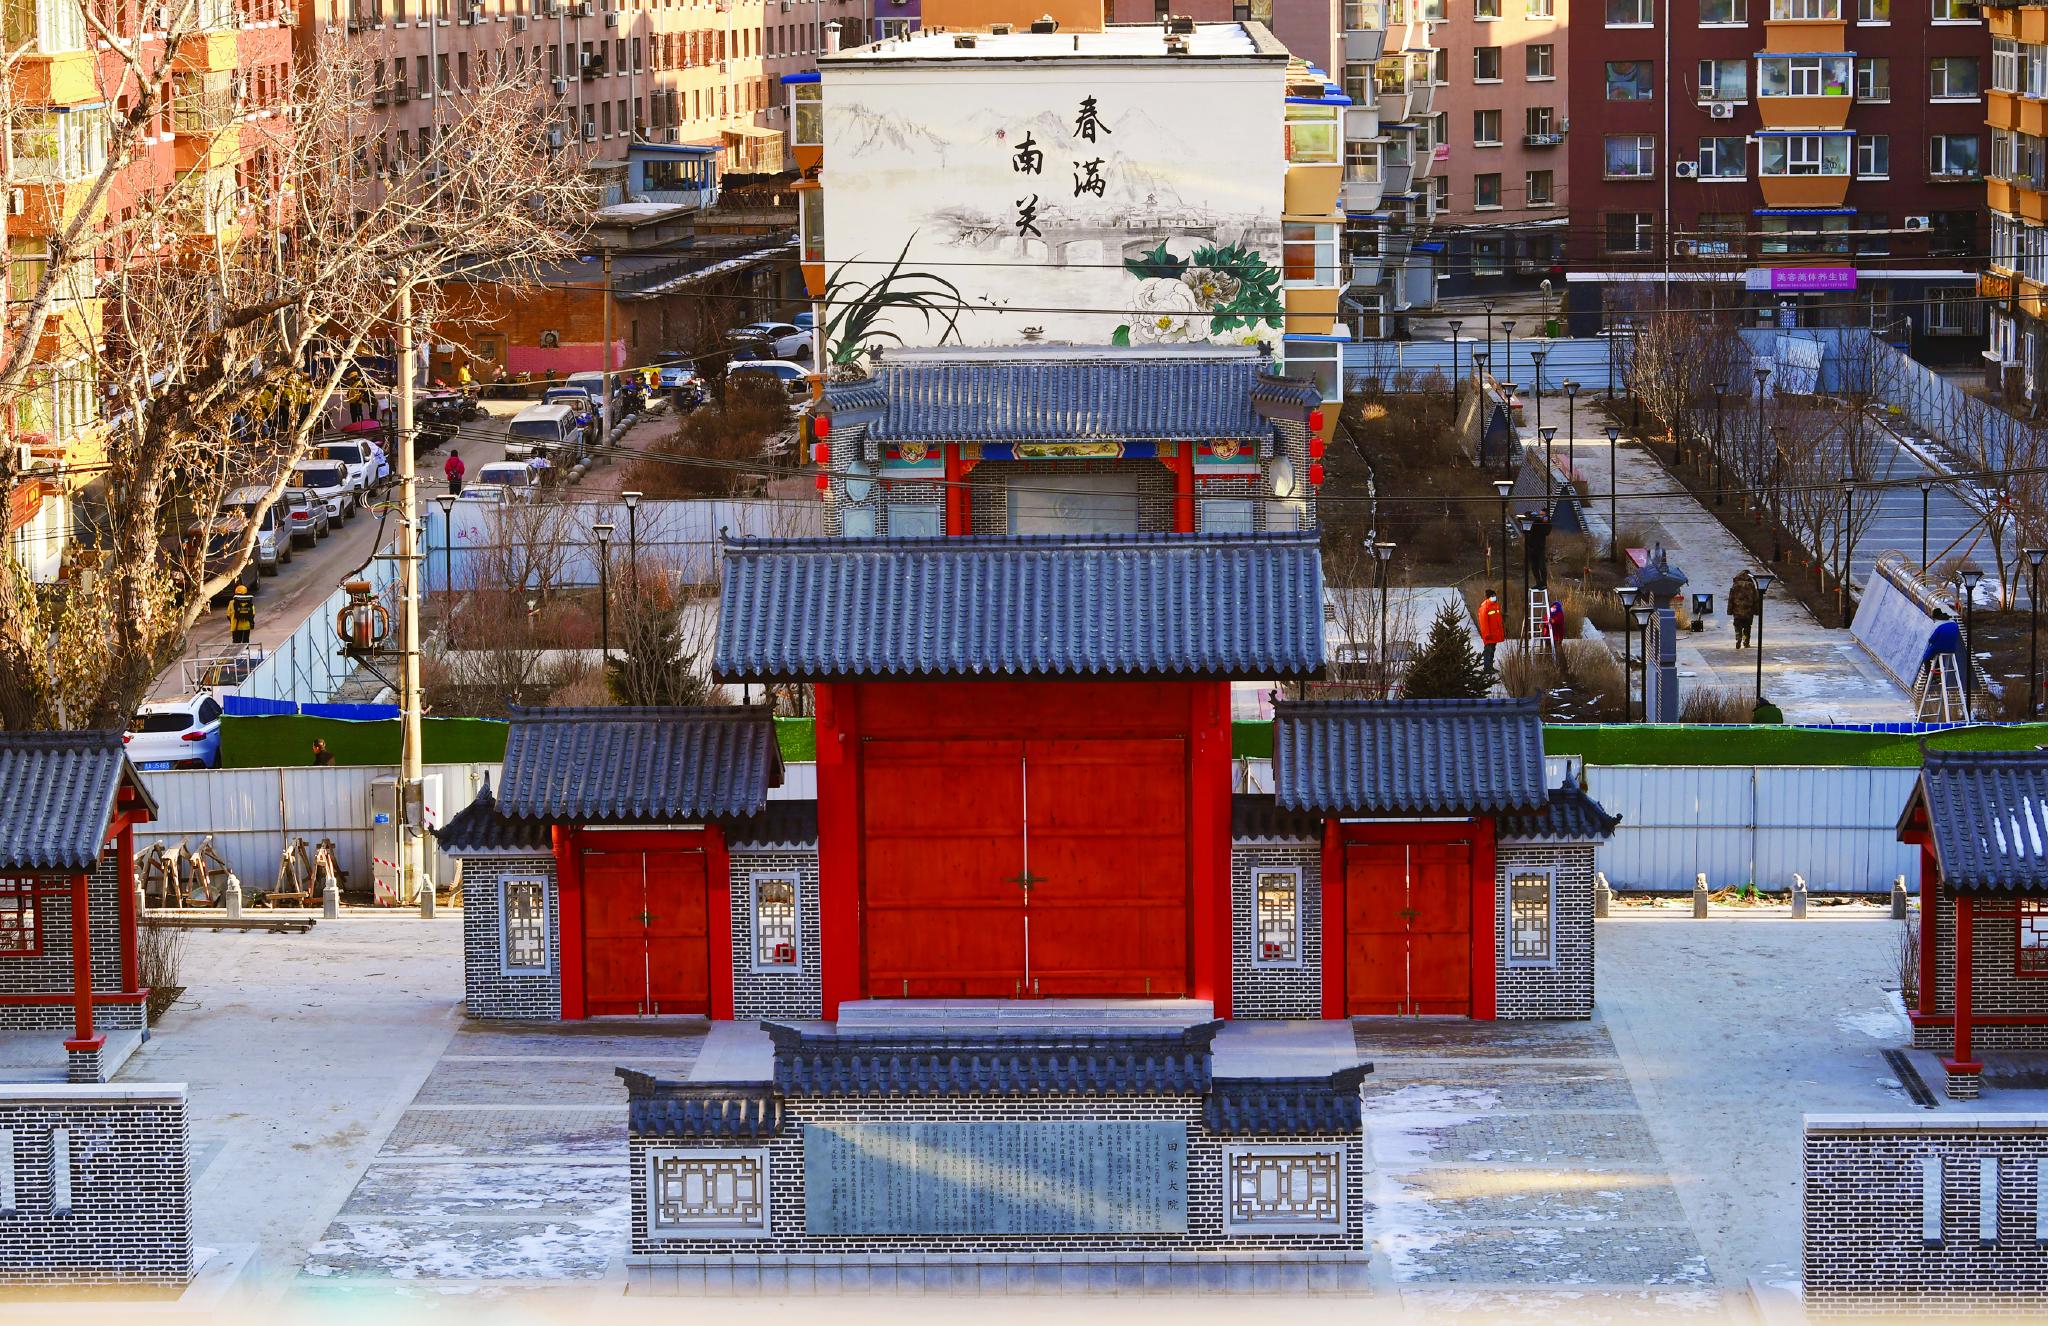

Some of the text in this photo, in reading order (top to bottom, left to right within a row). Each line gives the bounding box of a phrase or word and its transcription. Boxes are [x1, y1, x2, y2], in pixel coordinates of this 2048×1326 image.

[1013, 131, 1042, 237] 南关
[1073, 95, 1112, 198] 春满
[1167, 1142, 1180, 1211] 田家大院
